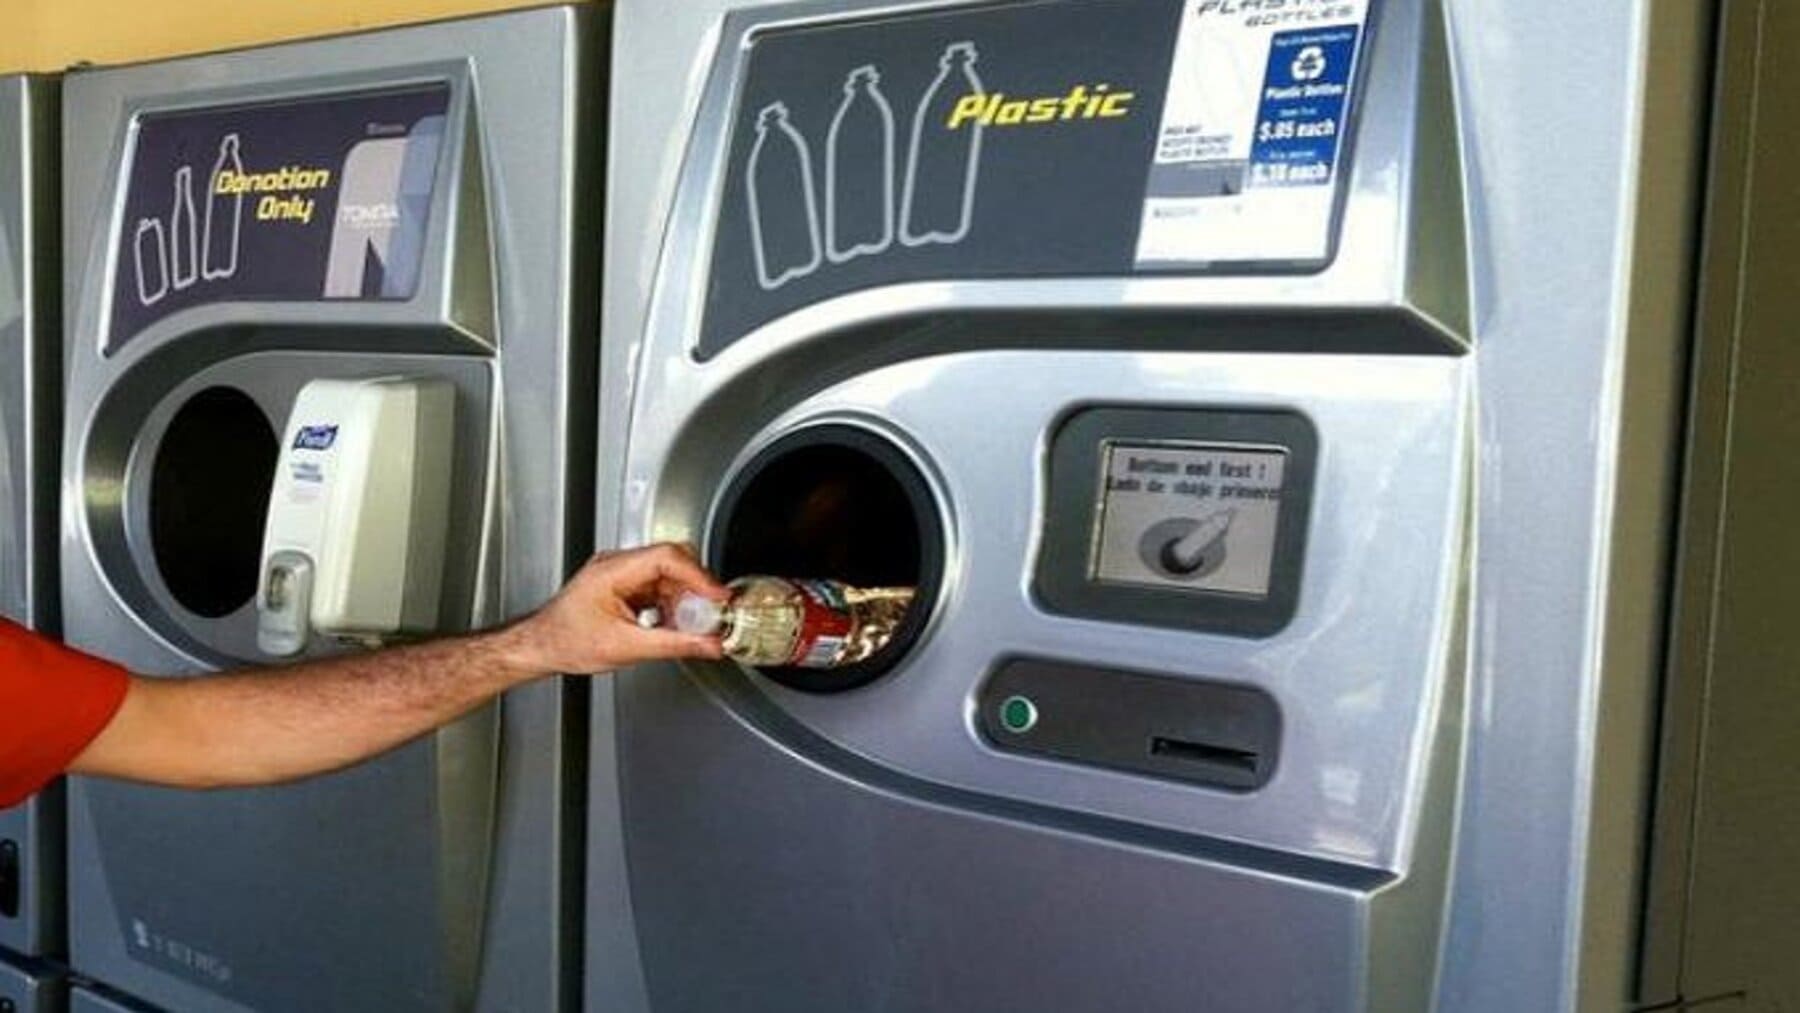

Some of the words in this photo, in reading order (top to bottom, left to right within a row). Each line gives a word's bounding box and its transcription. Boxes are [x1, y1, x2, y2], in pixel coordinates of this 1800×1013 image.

[1244, 5, 1354, 27] BOTTLES
[948, 84, 1135, 129] Plastic
[1297, 118, 1335, 137] each
[216, 166, 330, 194] Donation
[1289, 161, 1329, 179] each
[257, 196, 315, 223] Only
[1185, 460, 1213, 476] end
[1220, 462, 1252, 479] first
